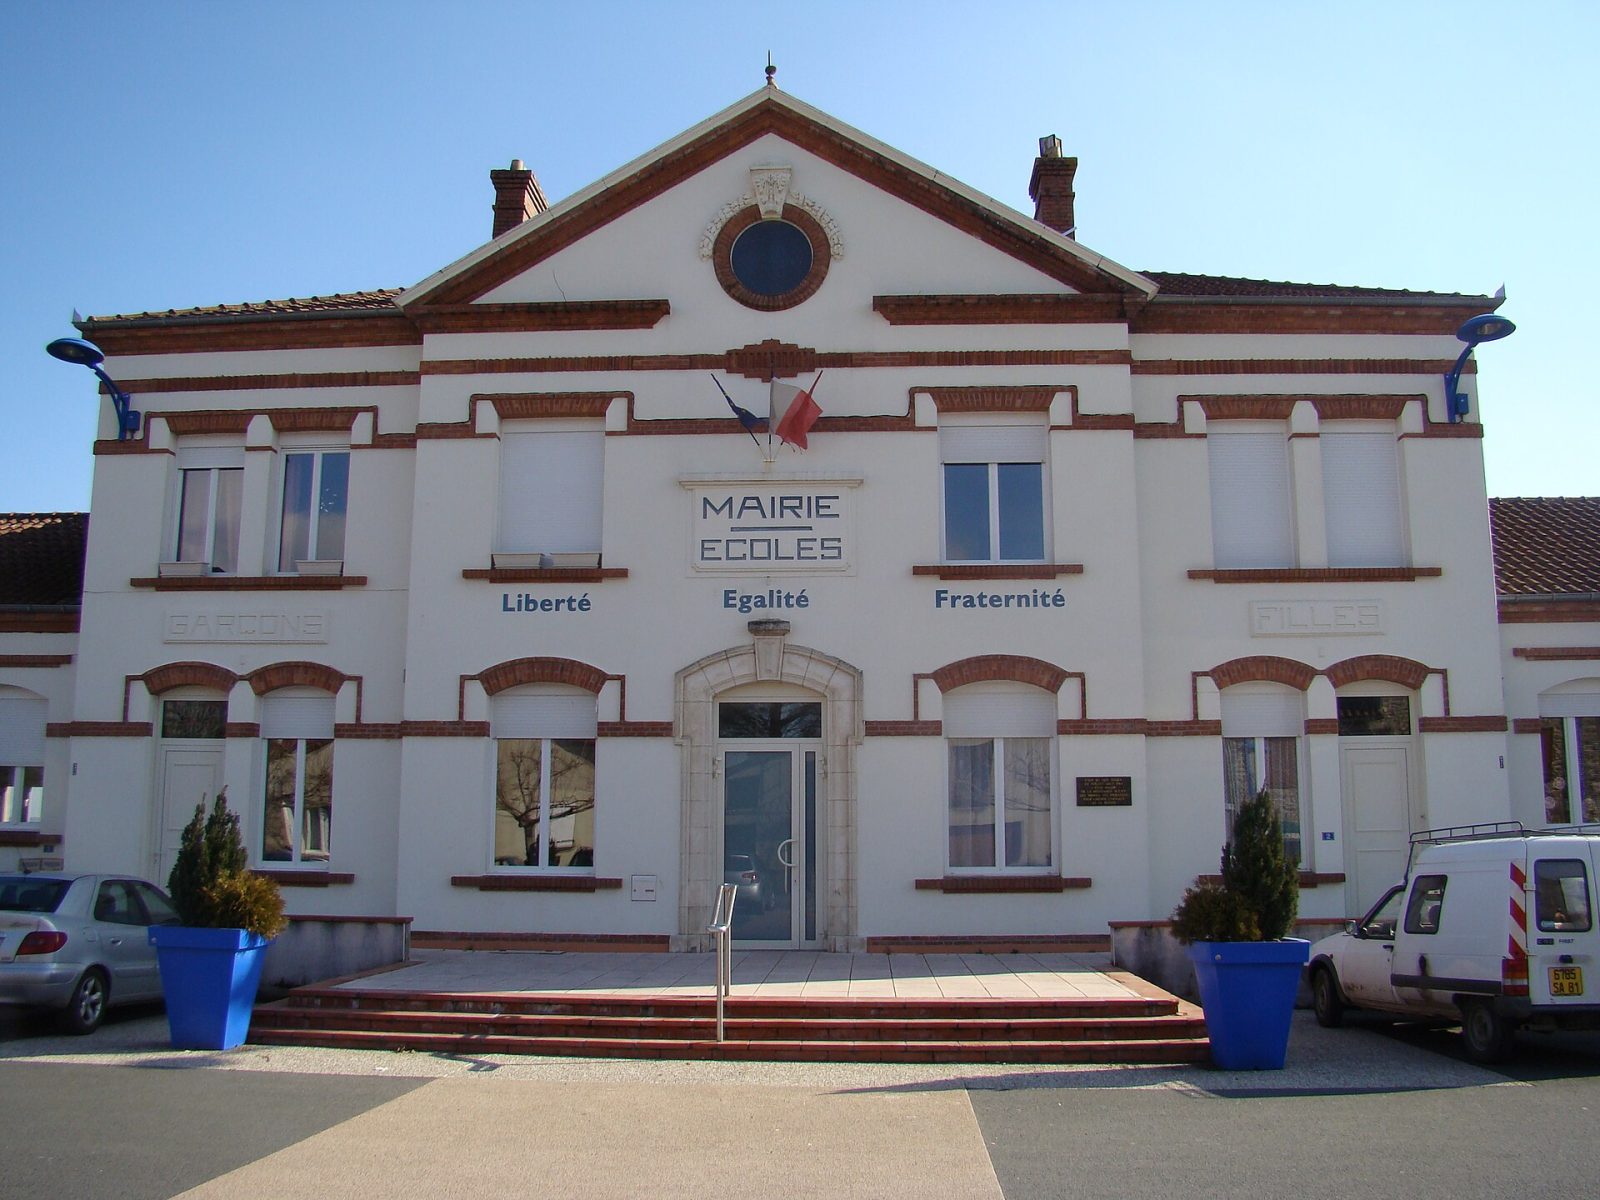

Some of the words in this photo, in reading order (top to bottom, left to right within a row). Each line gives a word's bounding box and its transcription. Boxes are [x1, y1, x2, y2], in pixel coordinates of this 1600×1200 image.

[702, 495, 840, 519] MAIRIE
[700, 537, 842, 561] ECOLES
[502, 593, 591, 612] Liberté
[723, 589, 809, 613] Egalité
[935, 588, 1066, 608] Fraternité
[1256, 605, 1379, 630] FILLES
[1553, 982, 1564, 993] SA
